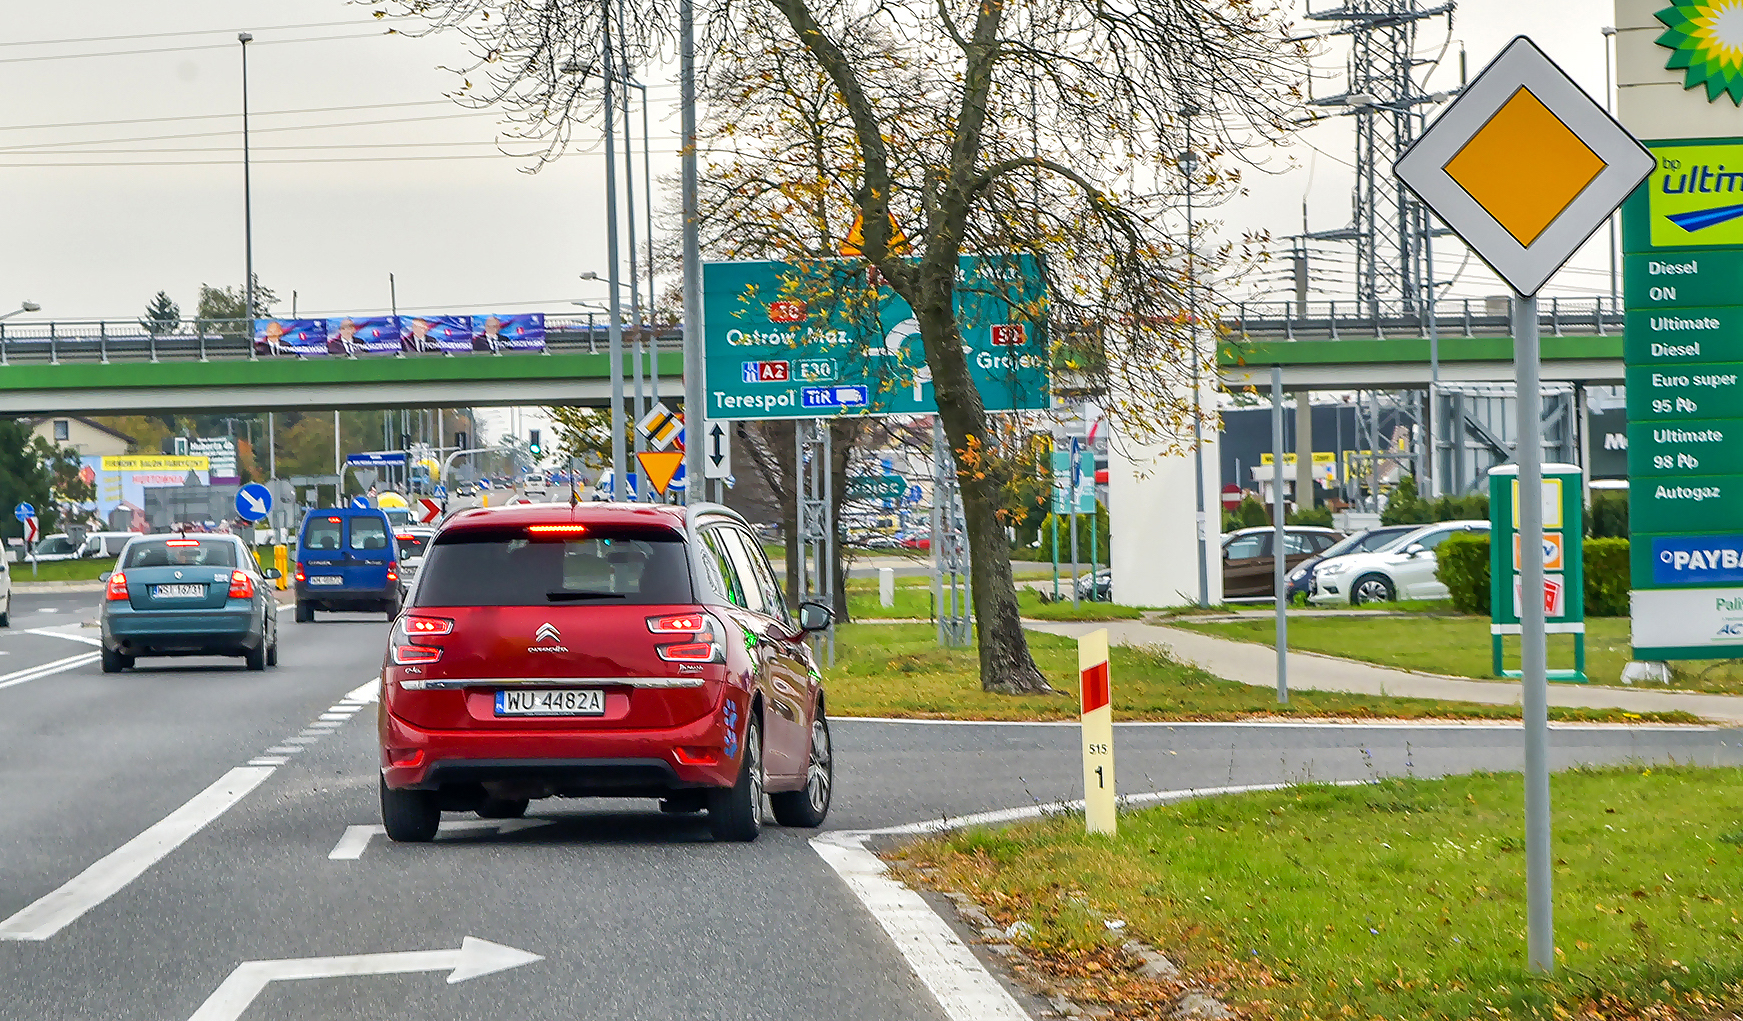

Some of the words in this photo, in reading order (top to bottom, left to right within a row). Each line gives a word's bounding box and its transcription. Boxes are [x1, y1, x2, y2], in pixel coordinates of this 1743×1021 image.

[1662, 156, 1681, 172] bp
[1648, 259, 1698, 276] Diesel
[1649, 286, 1676, 301] ON
[1650, 316, 1720, 332] Ultimate
[726, 327, 797, 347] Ostrów
[1651, 342, 1701, 357] Diesel
[762, 364, 785, 379] A2
[1652, 373, 1690, 387] Euro
[1692, 374, 1738, 389] super
[713, 389, 795, 413] Terespol
[1652, 399, 1673, 413] 95
[1676, 396, 1698, 413] Pb
[1653, 429, 1723, 444] Ultimate
[1653, 455, 1674, 469] 98
[1677, 452, 1699, 469] Pb
[1654, 485, 1721, 501] Autogaz
[1673, 549, 1743, 571] PAYB
[1716, 597, 1743, 611] Pali
[507, 691, 535, 710] WU
[541, 691, 600, 710] 4482A
[1089, 744, 1108, 755] 515
[1094, 765, 1104, 789] 1
